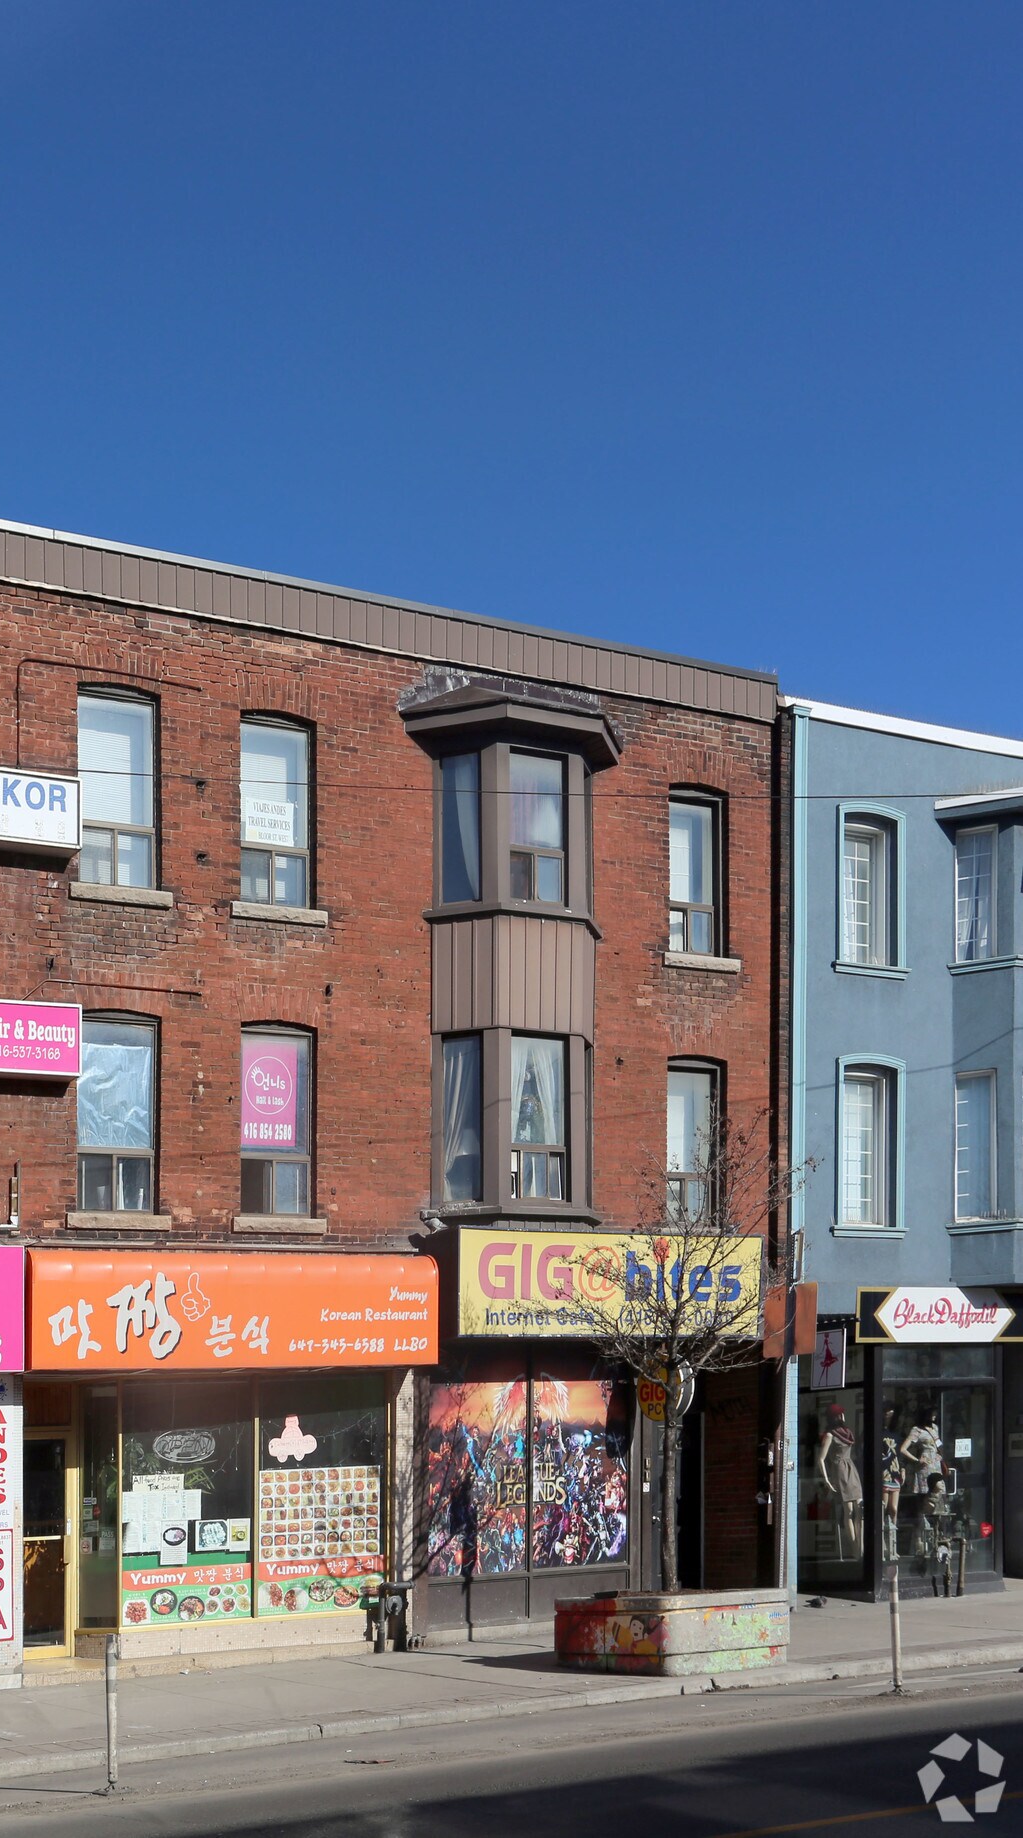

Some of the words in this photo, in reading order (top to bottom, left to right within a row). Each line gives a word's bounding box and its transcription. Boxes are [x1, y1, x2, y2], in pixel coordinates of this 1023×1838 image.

[248, 816, 267, 828] TRAVEL
[267, 818, 291, 831] SERVICES
[14, 1019, 25, 1040] &
[28, 1020, 76, 1048] Beauty
[244, 1122, 257, 1139] 416
[260, 1123, 273, 1140] 854
[275, 1124, 292, 1141] 2580
[389, 1286, 428, 1305] Yummy
[320, 1308, 361, 1322] Korean
[365, 1307, 428, 1322] Restaurant
[485, 1308, 551, 1327] Internet
[393, 1336, 428, 1352] LLBO
[266, 1563, 320, 1575] Yummy
[130, 1572, 187, 1585] Yummy
